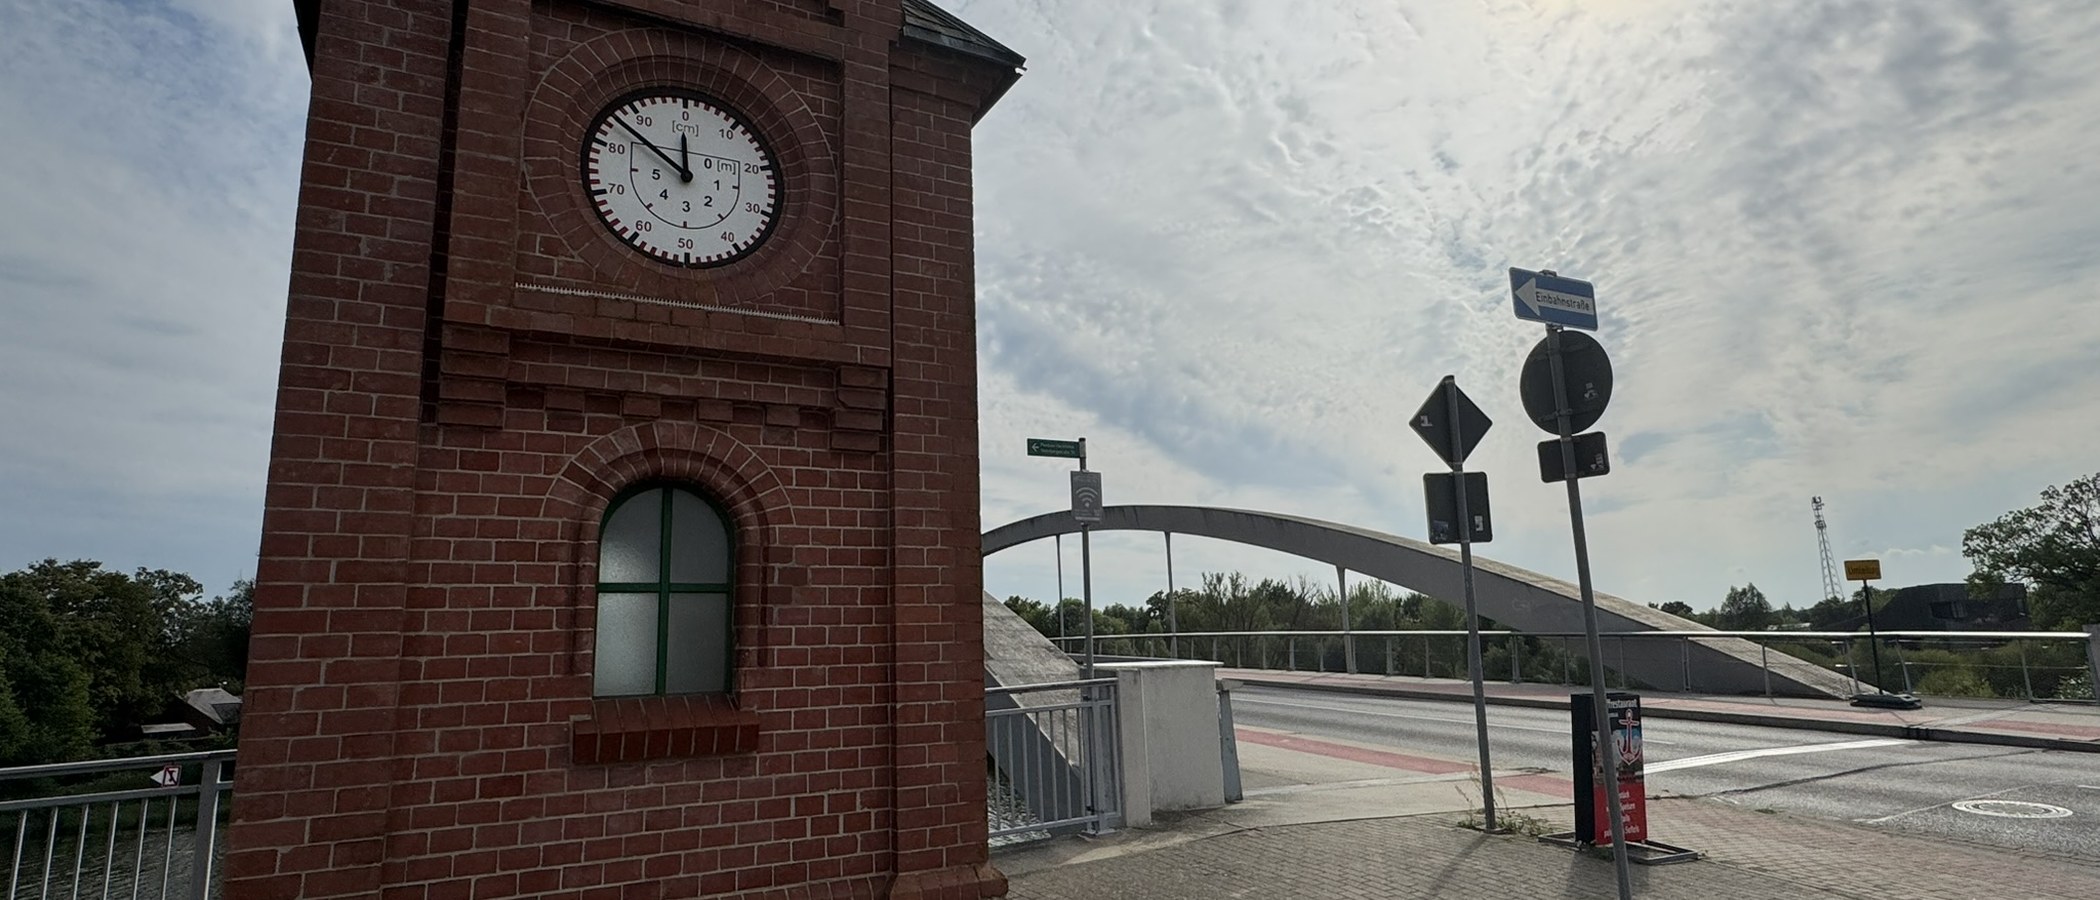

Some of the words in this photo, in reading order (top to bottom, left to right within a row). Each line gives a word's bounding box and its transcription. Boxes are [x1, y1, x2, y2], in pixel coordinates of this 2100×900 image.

[636, 115, 652, 126] 90
[682, 111, 690, 121] 0
[671, 120, 699, 137] [cm]
[719, 129, 734, 140] 10
[608, 142, 625, 155] 80
[704, 158, 712, 169] 0
[716, 160, 736, 175] [m]
[744, 162, 760, 175] 20
[652, 169, 661, 181] 5
[608, 183, 625, 195] 70
[714, 180, 720, 191] 1
[660, 189, 668, 200] 4
[682, 201, 690, 212] 3
[704, 195, 713, 208] 2
[745, 202, 760, 214] 30
[635, 220, 652, 233] 60
[720, 231, 735, 243] 40
[677, 237, 694, 250] 50
[1536, 292, 1589, 311] Einbahnstraße
